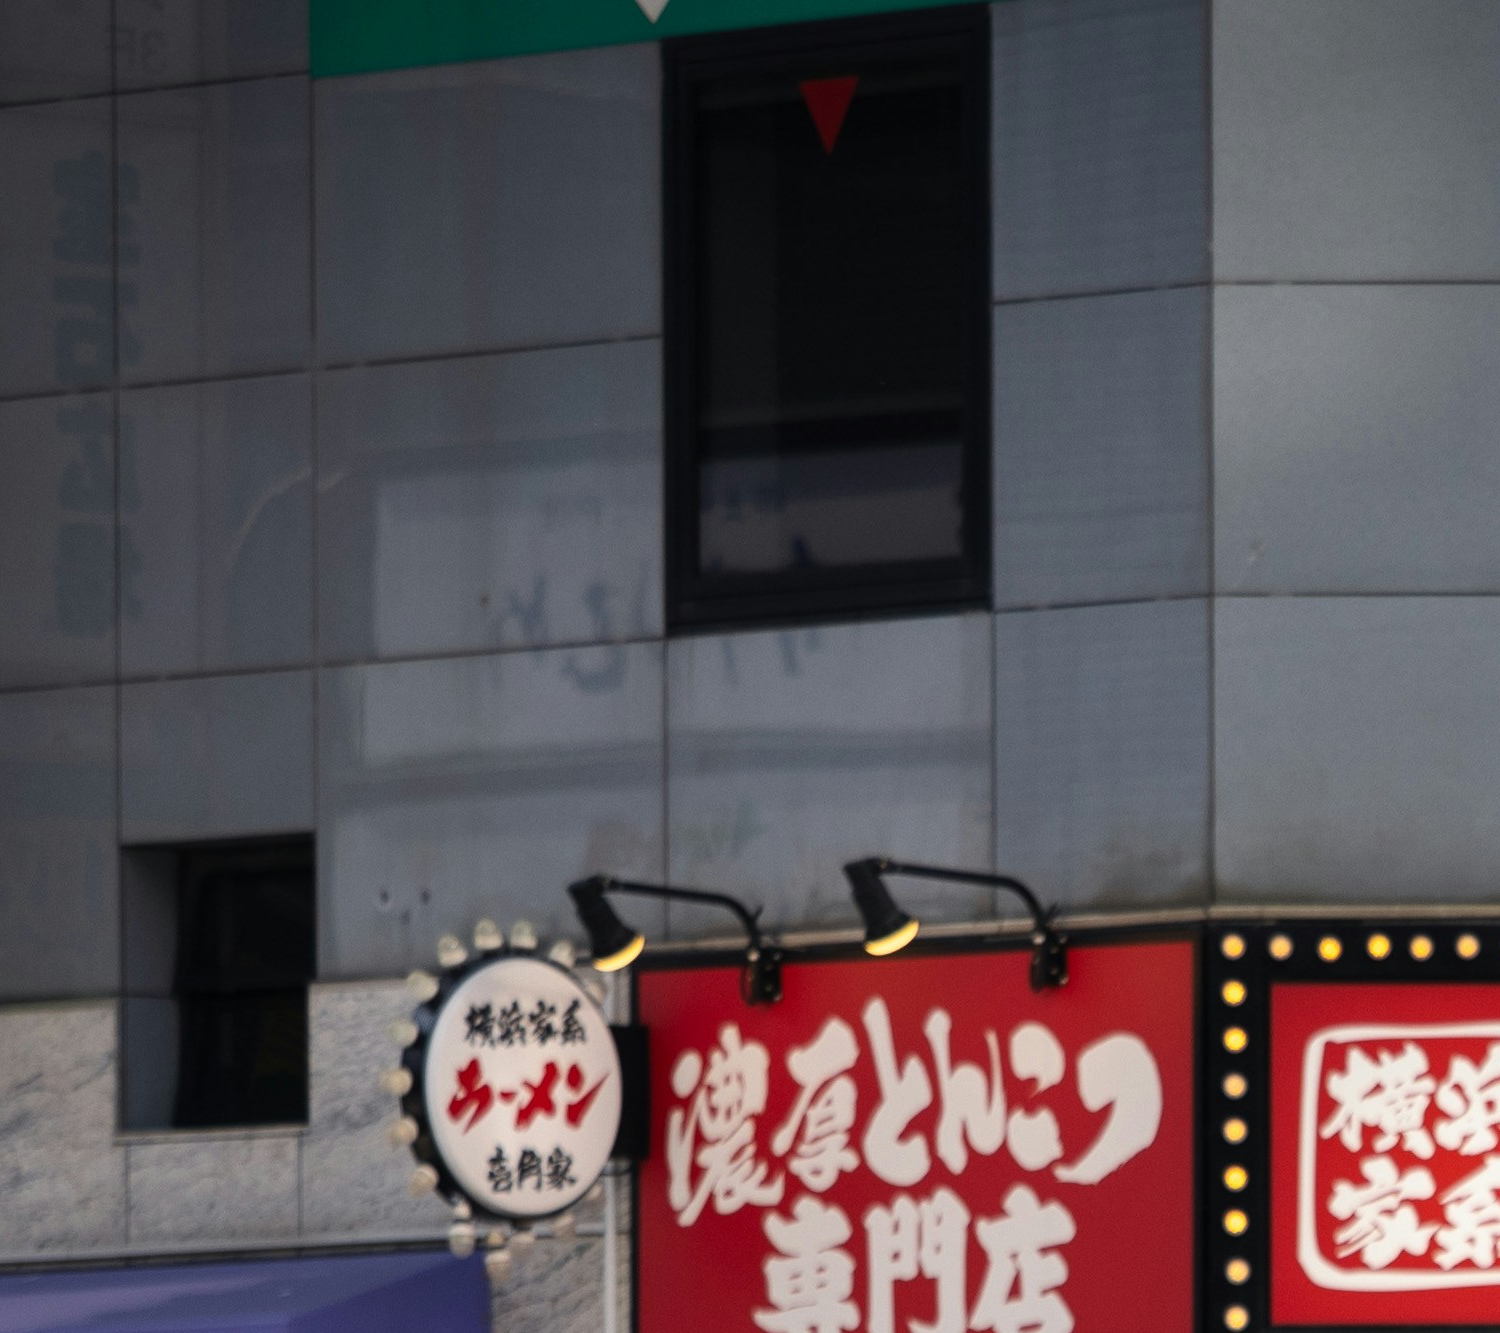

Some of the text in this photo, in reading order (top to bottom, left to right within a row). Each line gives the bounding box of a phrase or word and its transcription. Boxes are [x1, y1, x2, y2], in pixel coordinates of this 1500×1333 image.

[465, 999, 587, 1047] 横浜家系
[447, 1057, 611, 1135] ラーメン
[666, 997, 1163, 1228] 濃厚とんこつ
